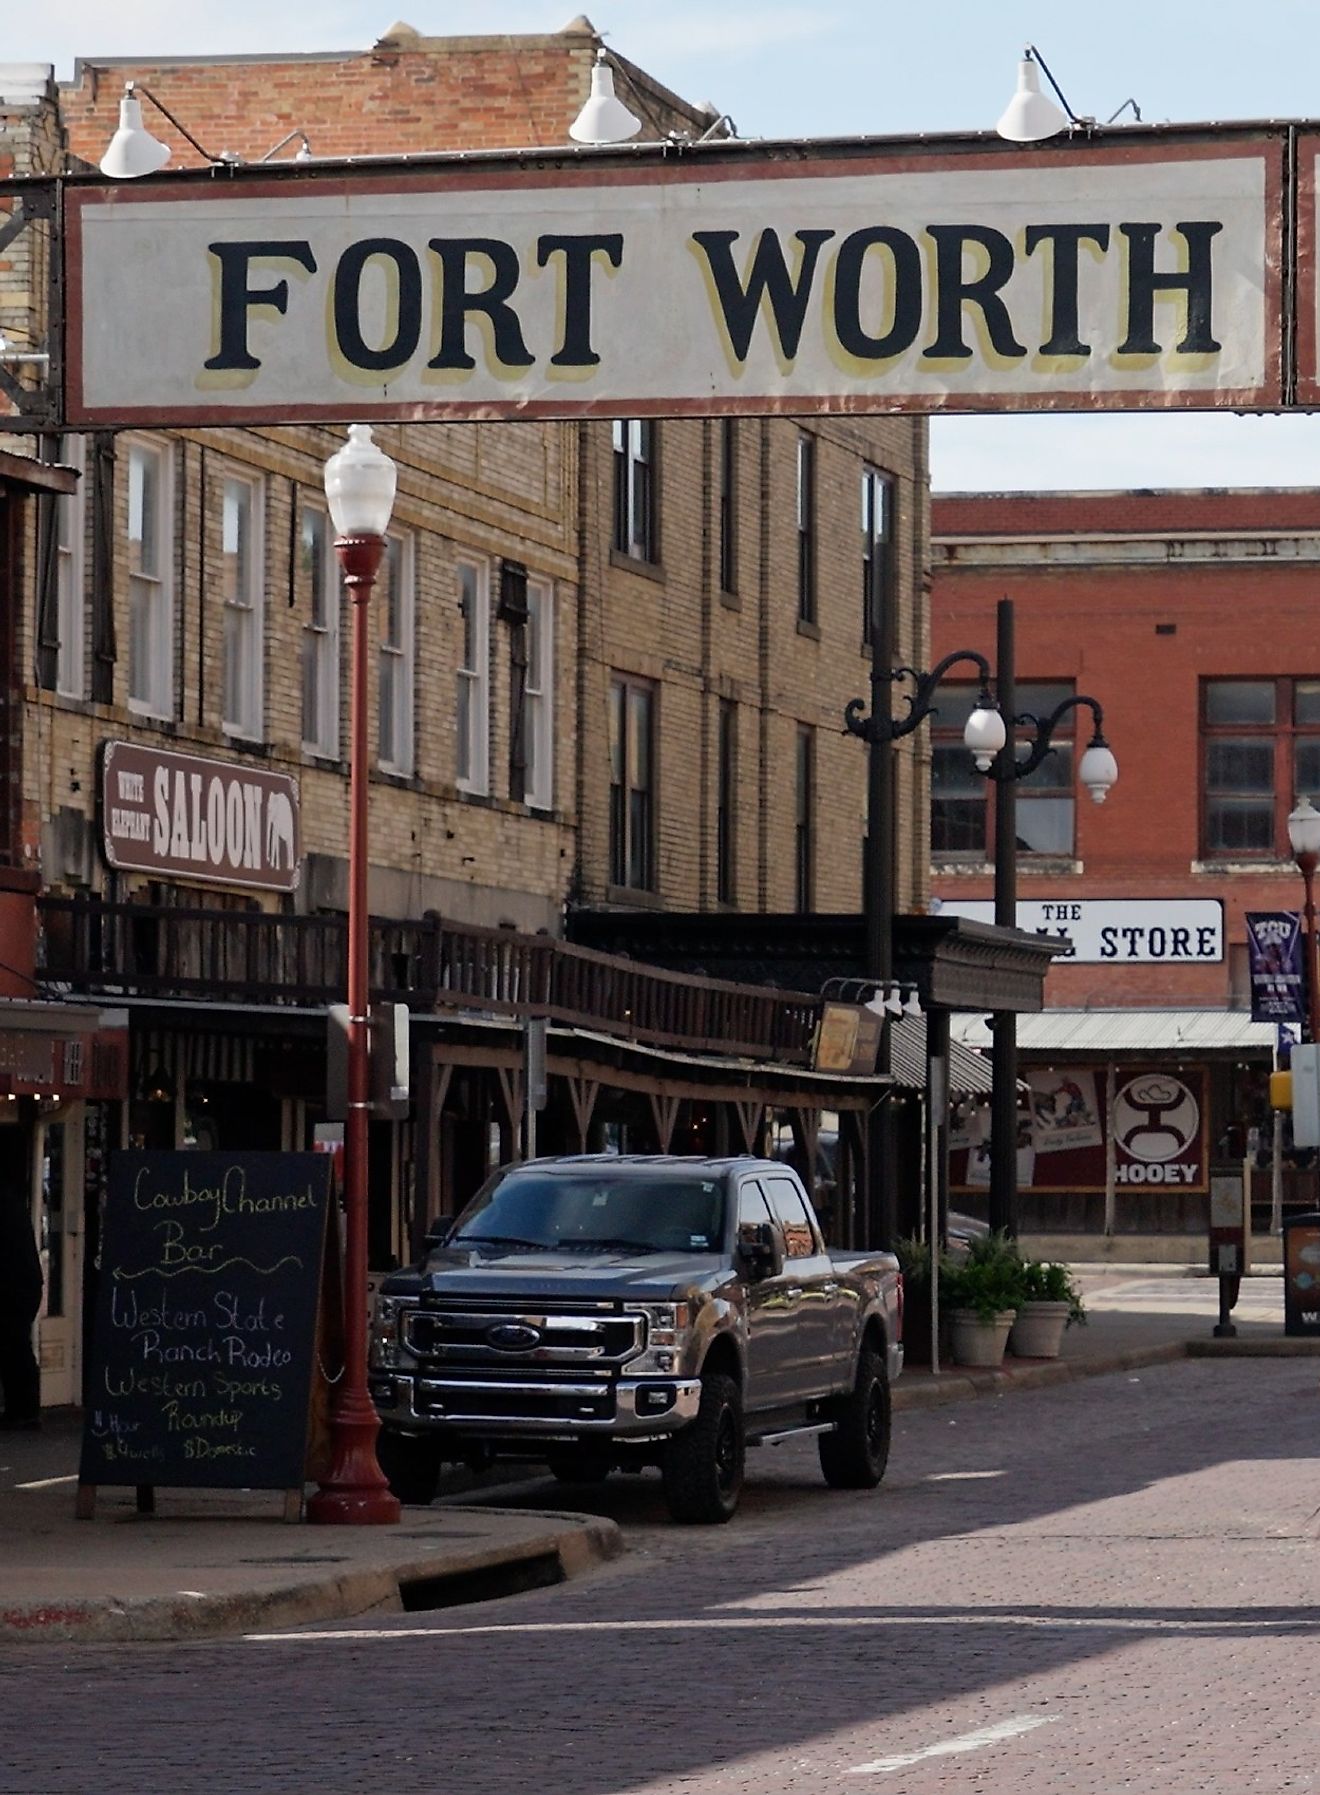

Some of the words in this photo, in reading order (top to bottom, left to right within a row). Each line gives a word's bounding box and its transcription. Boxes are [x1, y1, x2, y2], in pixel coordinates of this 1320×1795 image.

[203, 233, 624, 373] FORT
[691, 220, 1224, 363] WORTH
[153, 765, 263, 870] SALOON
[1042, 904, 1082, 920] THE
[1255, 920, 1292, 940] TCU
[1100, 927, 1217, 957] STORE
[1114, 1164, 1199, 1184] HOOEY
[134, 1166, 221, 1231] Cowboy
[222, 1165, 318, 1213] Channel
[153, 1220, 224, 1264] Bar
[111, 1287, 207, 1330] Western
[131, 1328, 222, 1363] Ranch
[222, 1335, 292, 1368] Rodeo
[105, 1366, 206, 1396] Western
[215, 1371, 283, 1402] Sports
[161, 1400, 243, 1431] Roundup
